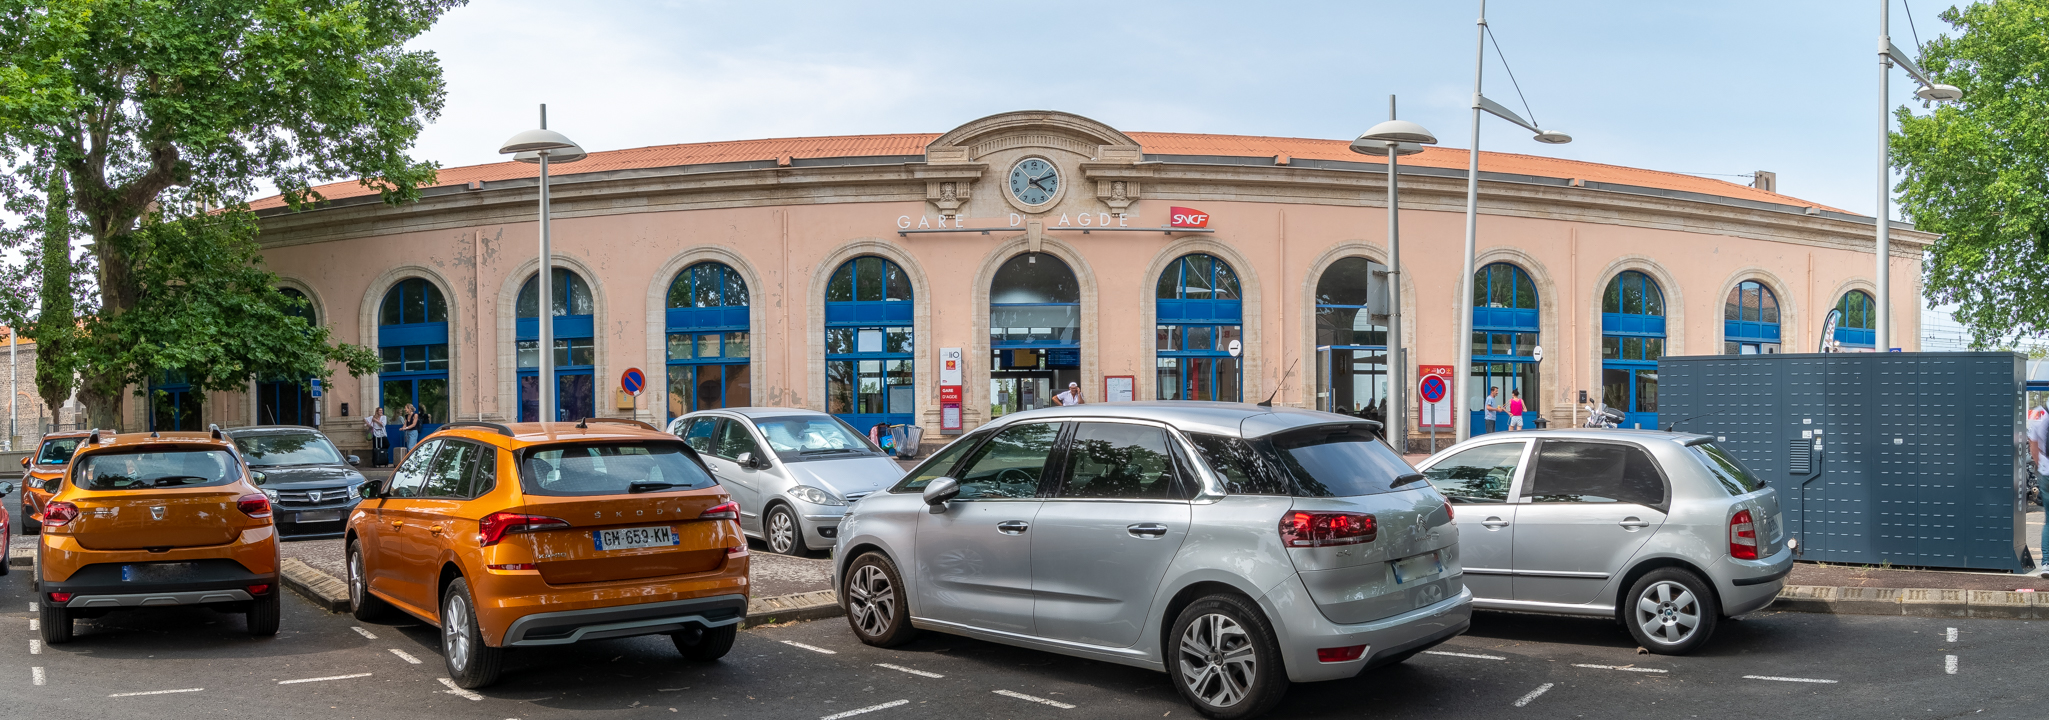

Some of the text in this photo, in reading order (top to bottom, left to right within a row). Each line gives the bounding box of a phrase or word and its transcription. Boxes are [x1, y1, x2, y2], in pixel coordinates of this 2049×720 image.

[897, 212, 1128, 229] GARE D' AGDE
[1172, 214, 1207, 224] SNCF
[603, 528, 670, 546] GM-659-KM
